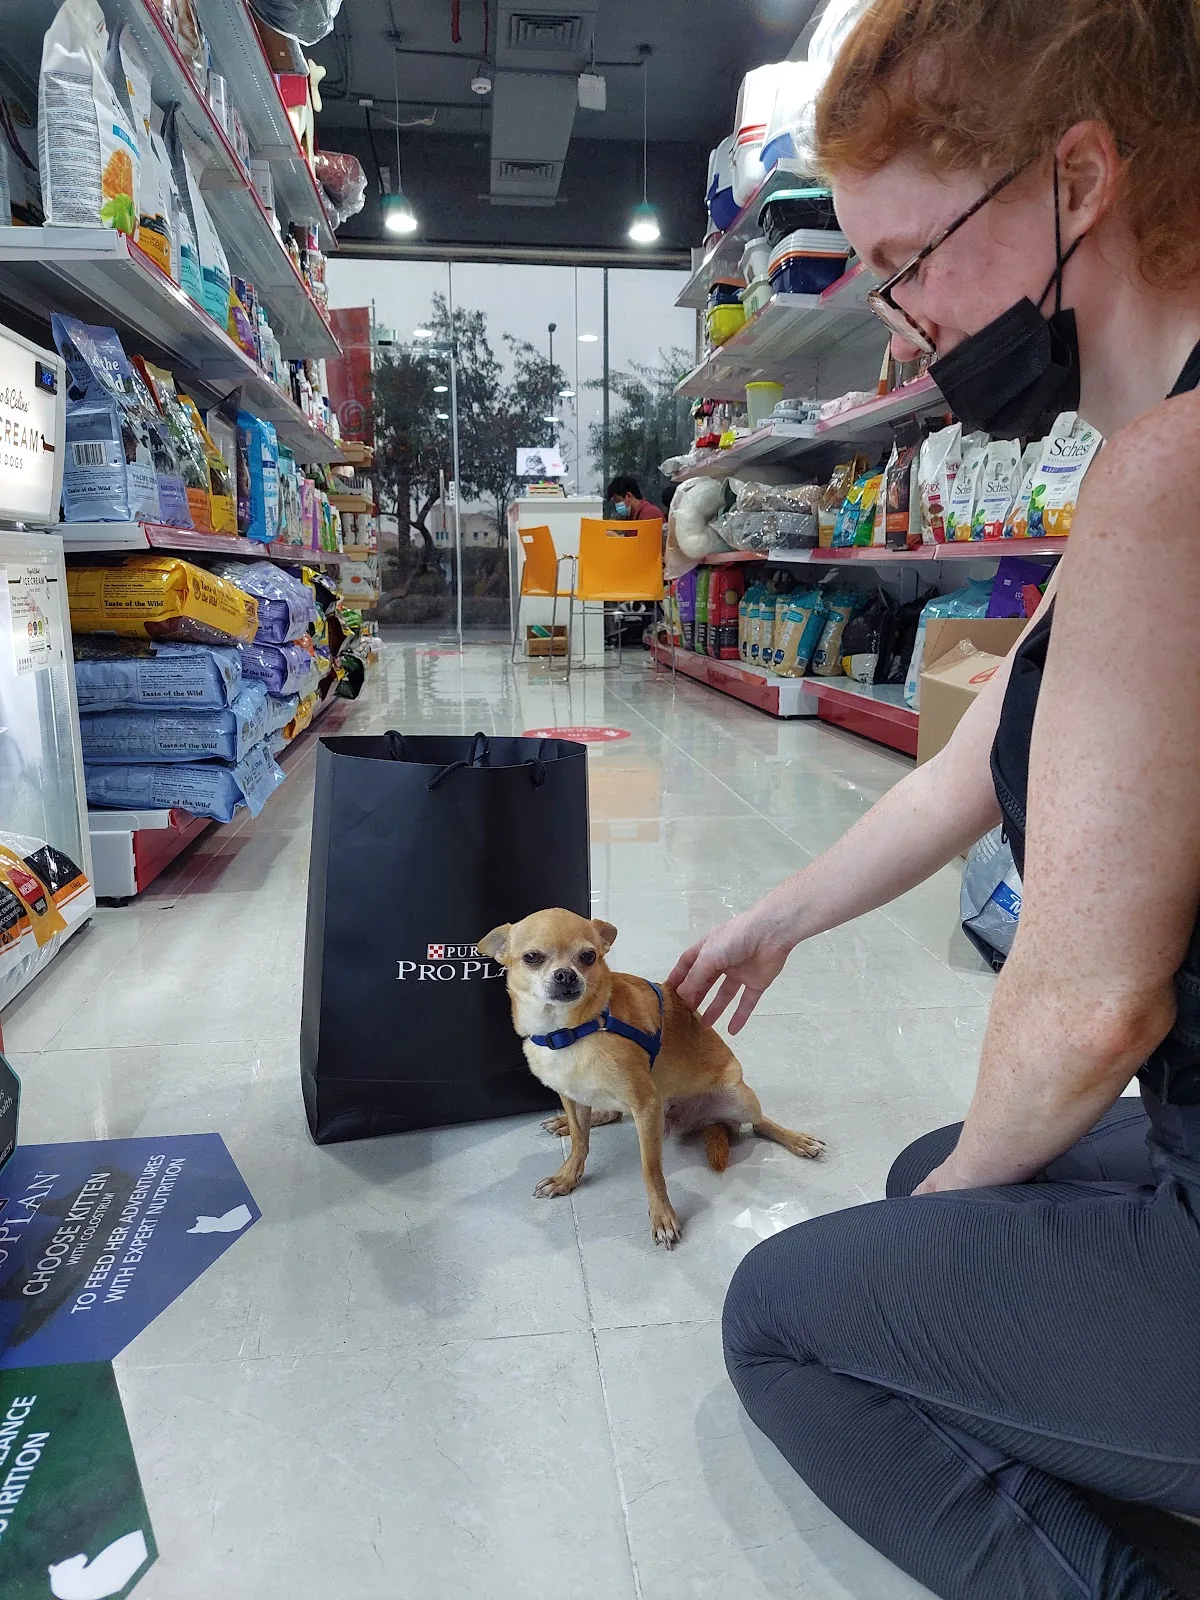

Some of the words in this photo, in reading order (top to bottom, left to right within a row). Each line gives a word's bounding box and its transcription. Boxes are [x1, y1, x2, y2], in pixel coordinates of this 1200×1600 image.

[4, 454, 23, 469] DOGS
[152, 797, 171, 805] Taste
[395, 960, 456, 981] PRO
[447, 946, 482, 958] PUR
[22, 1226, 82, 1296] CHOOSE
[64, 1172, 111, 1222] KITTEN
[66, 1242, 89, 1266] WITH
[80, 1192, 116, 1241] COLOSTRUM
[70, 1292, 98, 1314] TO
[84, 1254, 116, 1289] FEED
[103, 1226, 131, 1251] HER
[119, 1154, 166, 1223] ADVENTURES
[103, 1266, 137, 1304] WITH
[122, 1219, 159, 1264] EXPERT
[147, 1158, 187, 1215] NUTRITION
